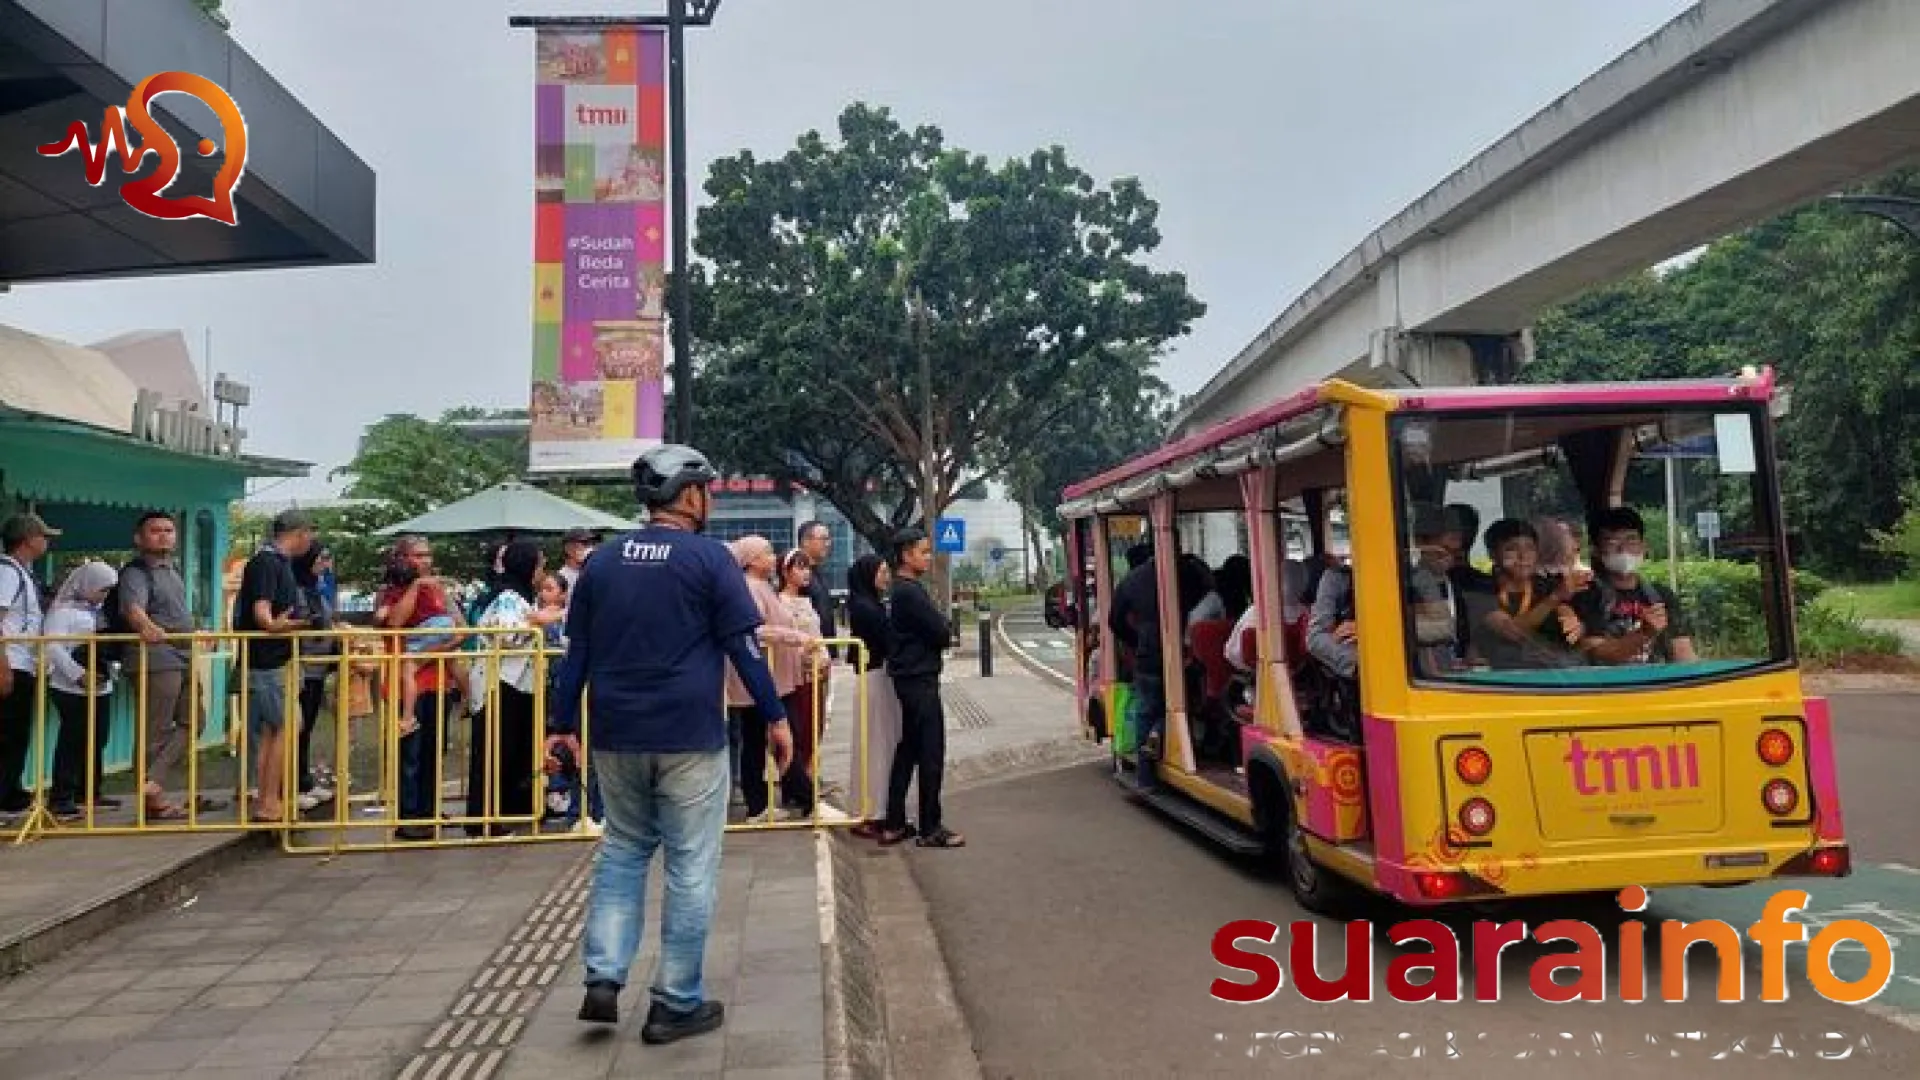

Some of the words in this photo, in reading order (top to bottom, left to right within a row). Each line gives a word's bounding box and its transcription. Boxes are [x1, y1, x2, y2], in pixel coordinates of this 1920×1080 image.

[568, 235, 634, 250] #Sudah
[579, 254, 623, 270] Beda
[579, 273, 631, 289] Cerita
